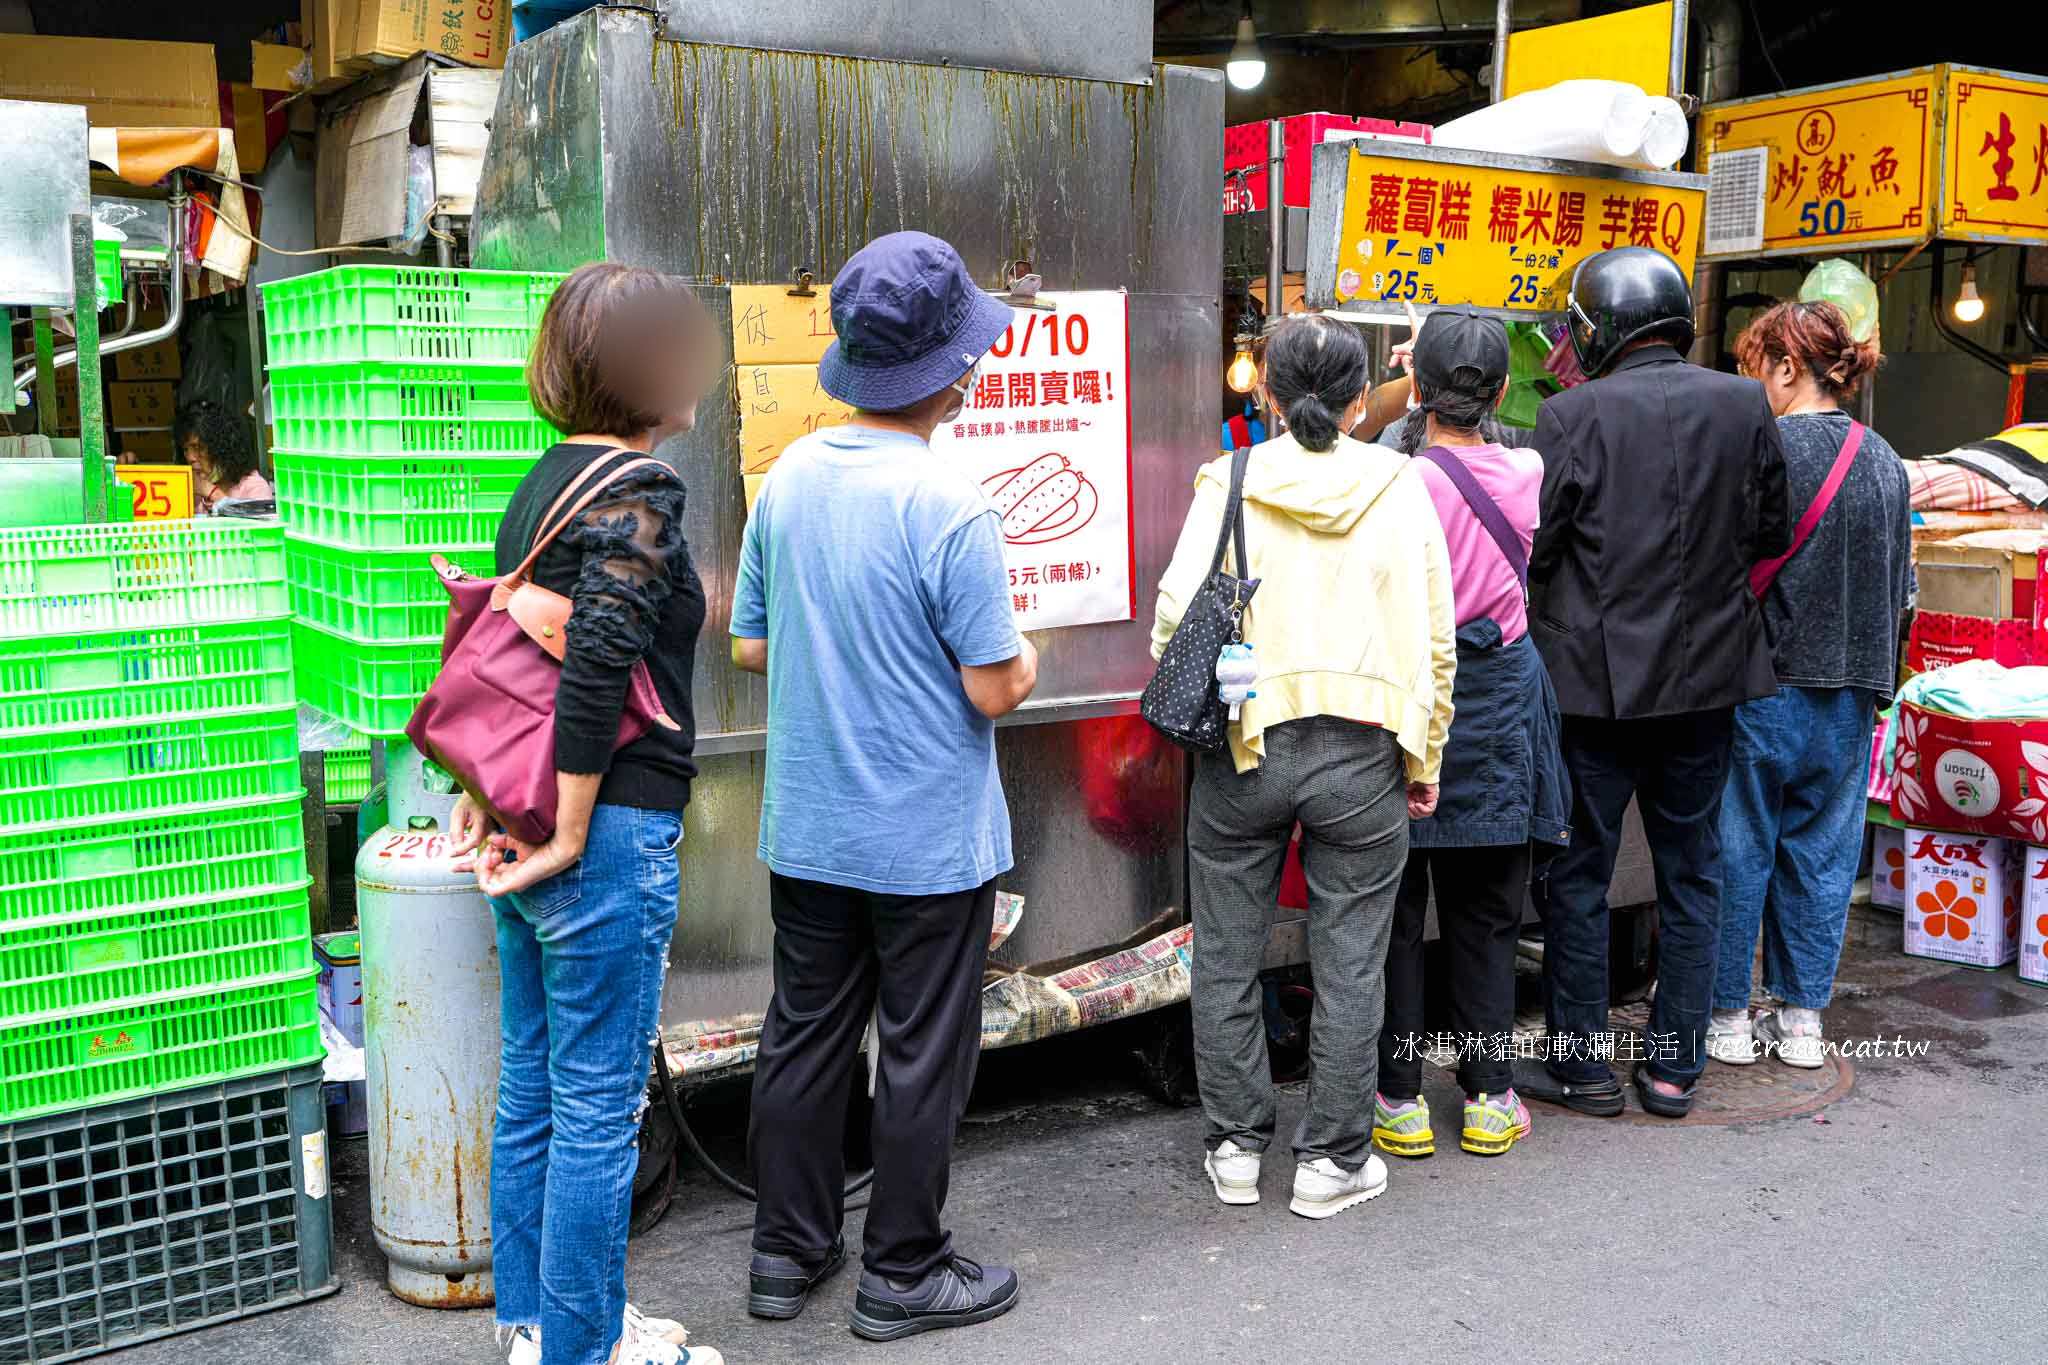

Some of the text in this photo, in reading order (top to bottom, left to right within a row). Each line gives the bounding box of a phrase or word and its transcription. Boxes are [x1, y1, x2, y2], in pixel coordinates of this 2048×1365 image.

[1771, 147, 1900, 210] 炒魷魚
[1364, 173, 1472, 241] 蘿蔔糕
[1488, 184, 1586, 248] 糯米腸
[1599, 194, 1685, 255] 芋粿Q
[1798, 199, 1863, 237] 50元
[1397, 247, 1433, 265] 一個
[1386, 269, 1434, 300] 25元
[966, 371, 1114, 409] 腸開賣囉!
[1944, 762, 1986, 782] frusan
